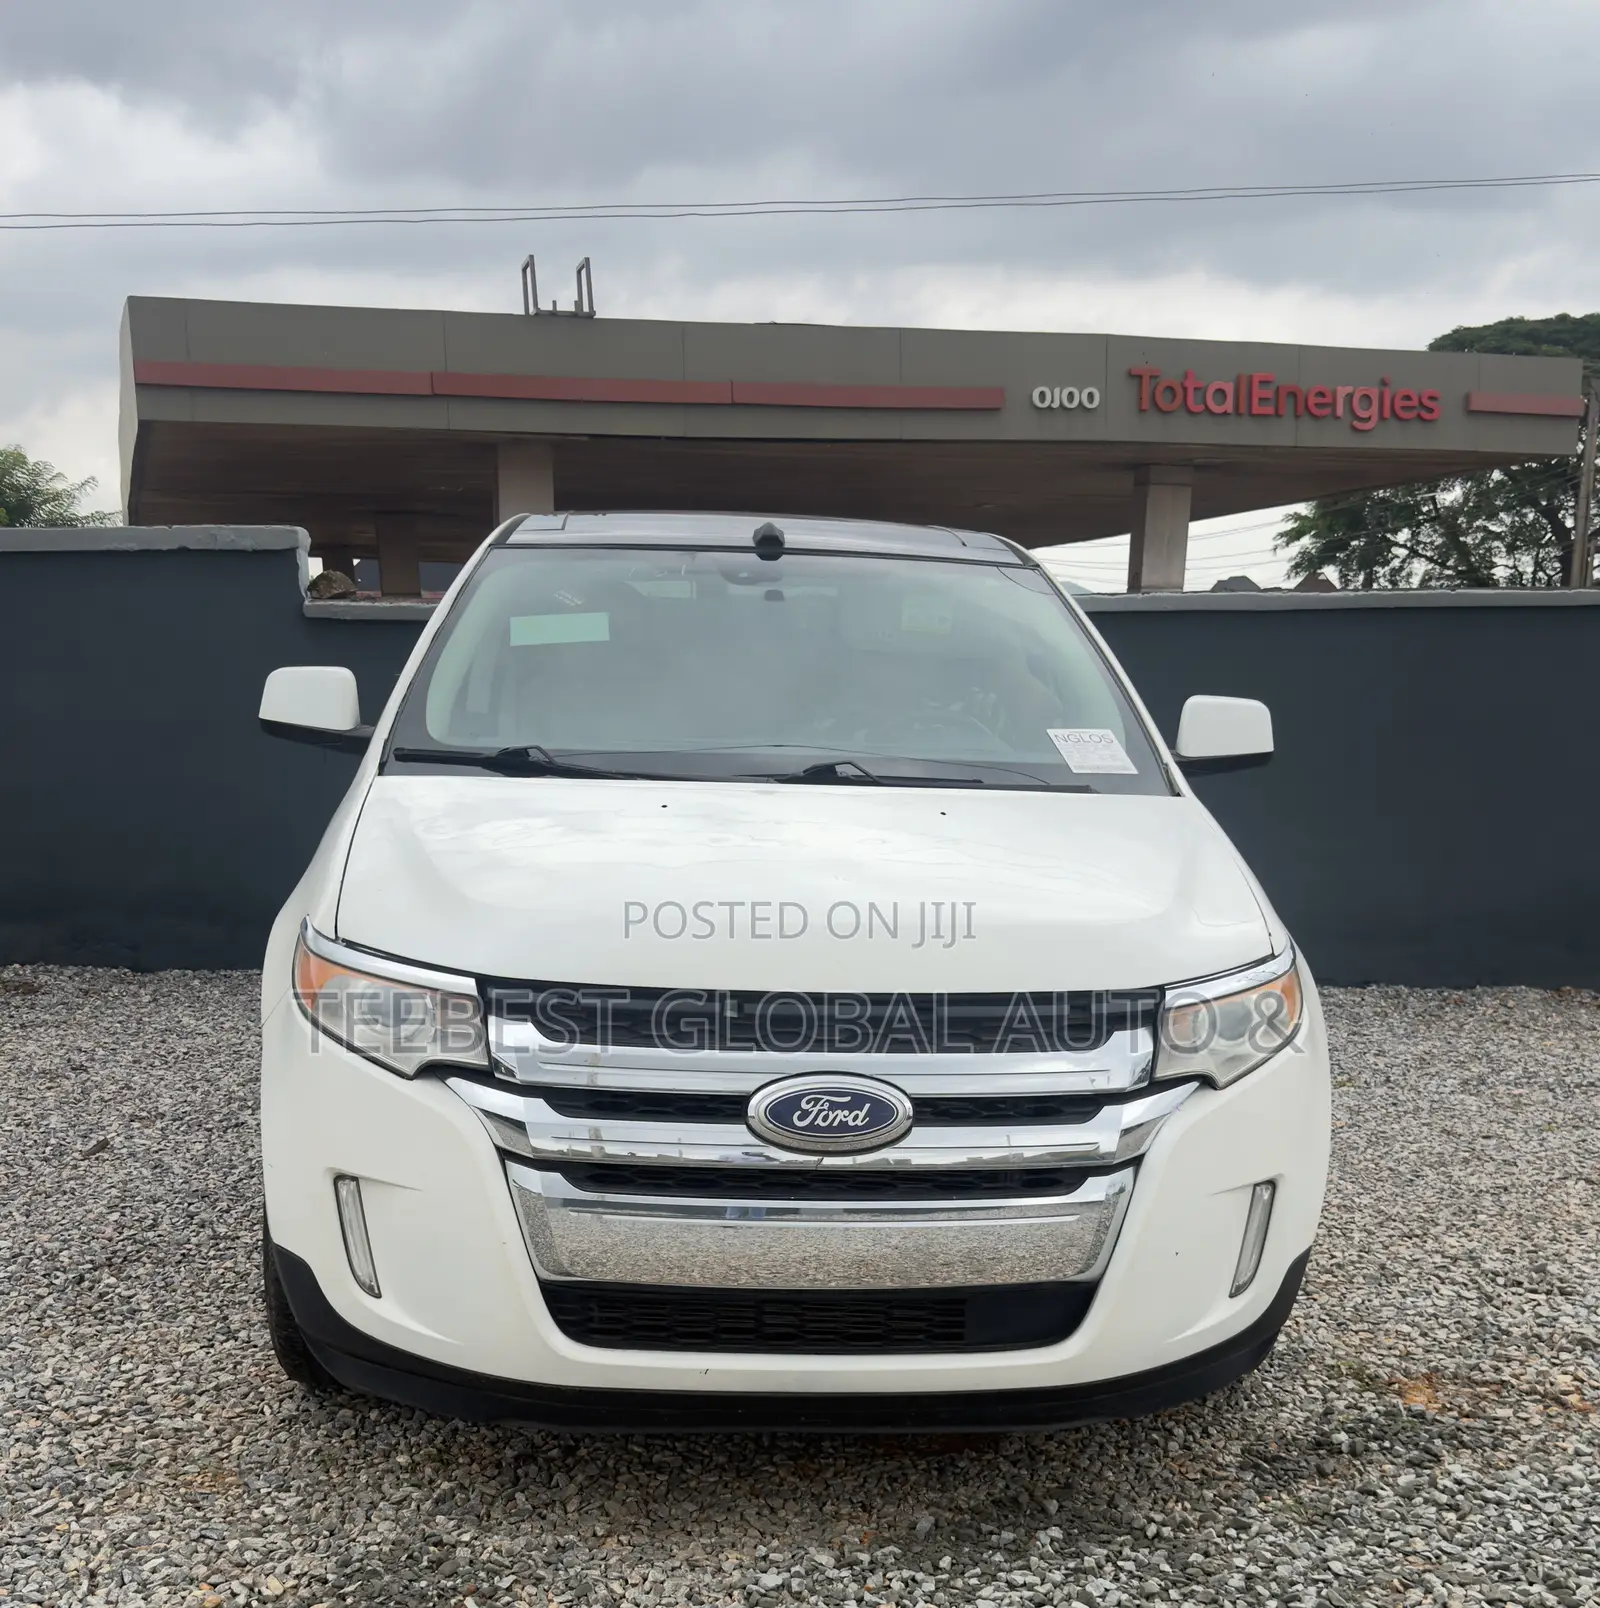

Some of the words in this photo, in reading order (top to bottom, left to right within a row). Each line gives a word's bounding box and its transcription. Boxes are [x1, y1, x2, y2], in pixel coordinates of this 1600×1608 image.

[1129, 366, 1441, 431] TotalEnergies
[1054, 733, 1114, 744] NGLOS
[792, 1094, 870, 1127] Ford
